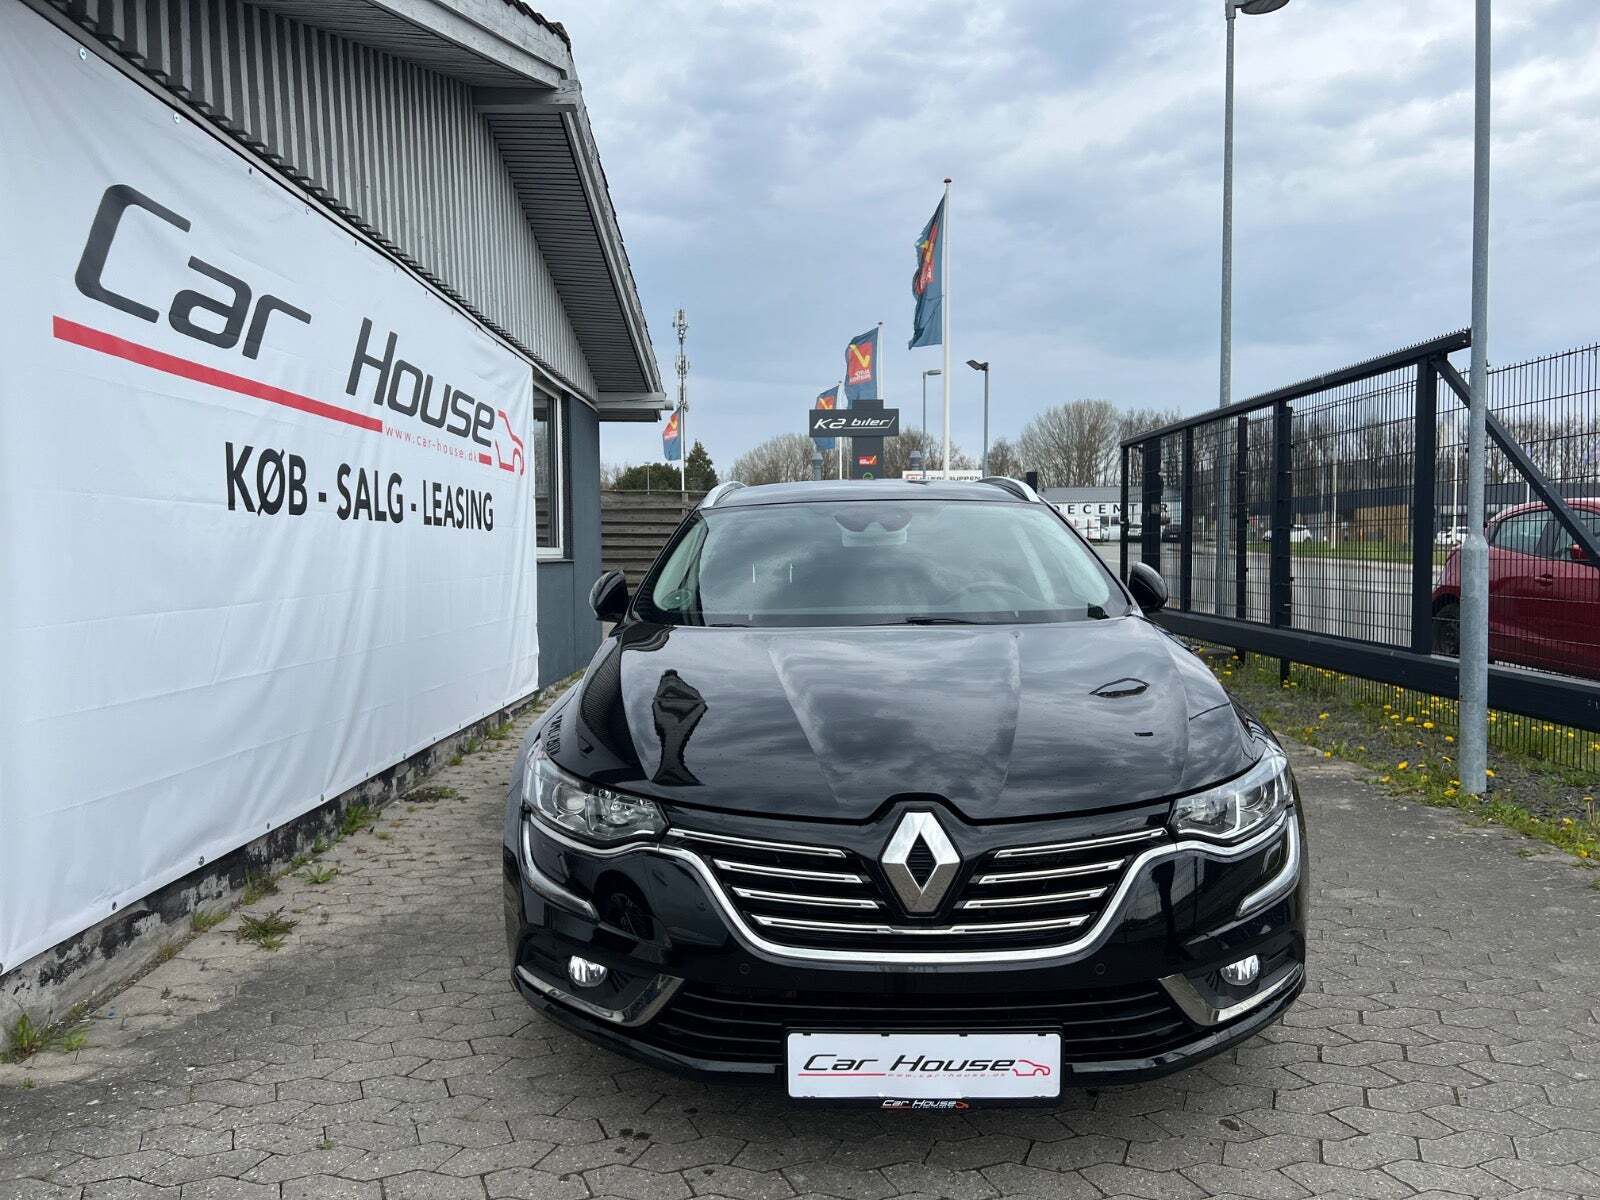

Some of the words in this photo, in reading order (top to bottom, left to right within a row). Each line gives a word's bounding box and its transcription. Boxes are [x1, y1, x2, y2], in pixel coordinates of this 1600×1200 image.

[75, 184, 312, 360] Car
[345, 317, 496, 448] House
[814, 418, 847, 429] K2
[851, 417, 890, 426] biler
[385, 426, 478, 464] www.car-house.dk
[225, 441, 308, 517] KØB
[336, 463, 404, 524] SALG
[423, 479, 494, 531] LEASING
[803, 1054, 879, 1071] Car
[889, 1054, 1016, 1072] House
[882, 1099, 910, 1107] Car
[911, 1099, 957, 1109] House
